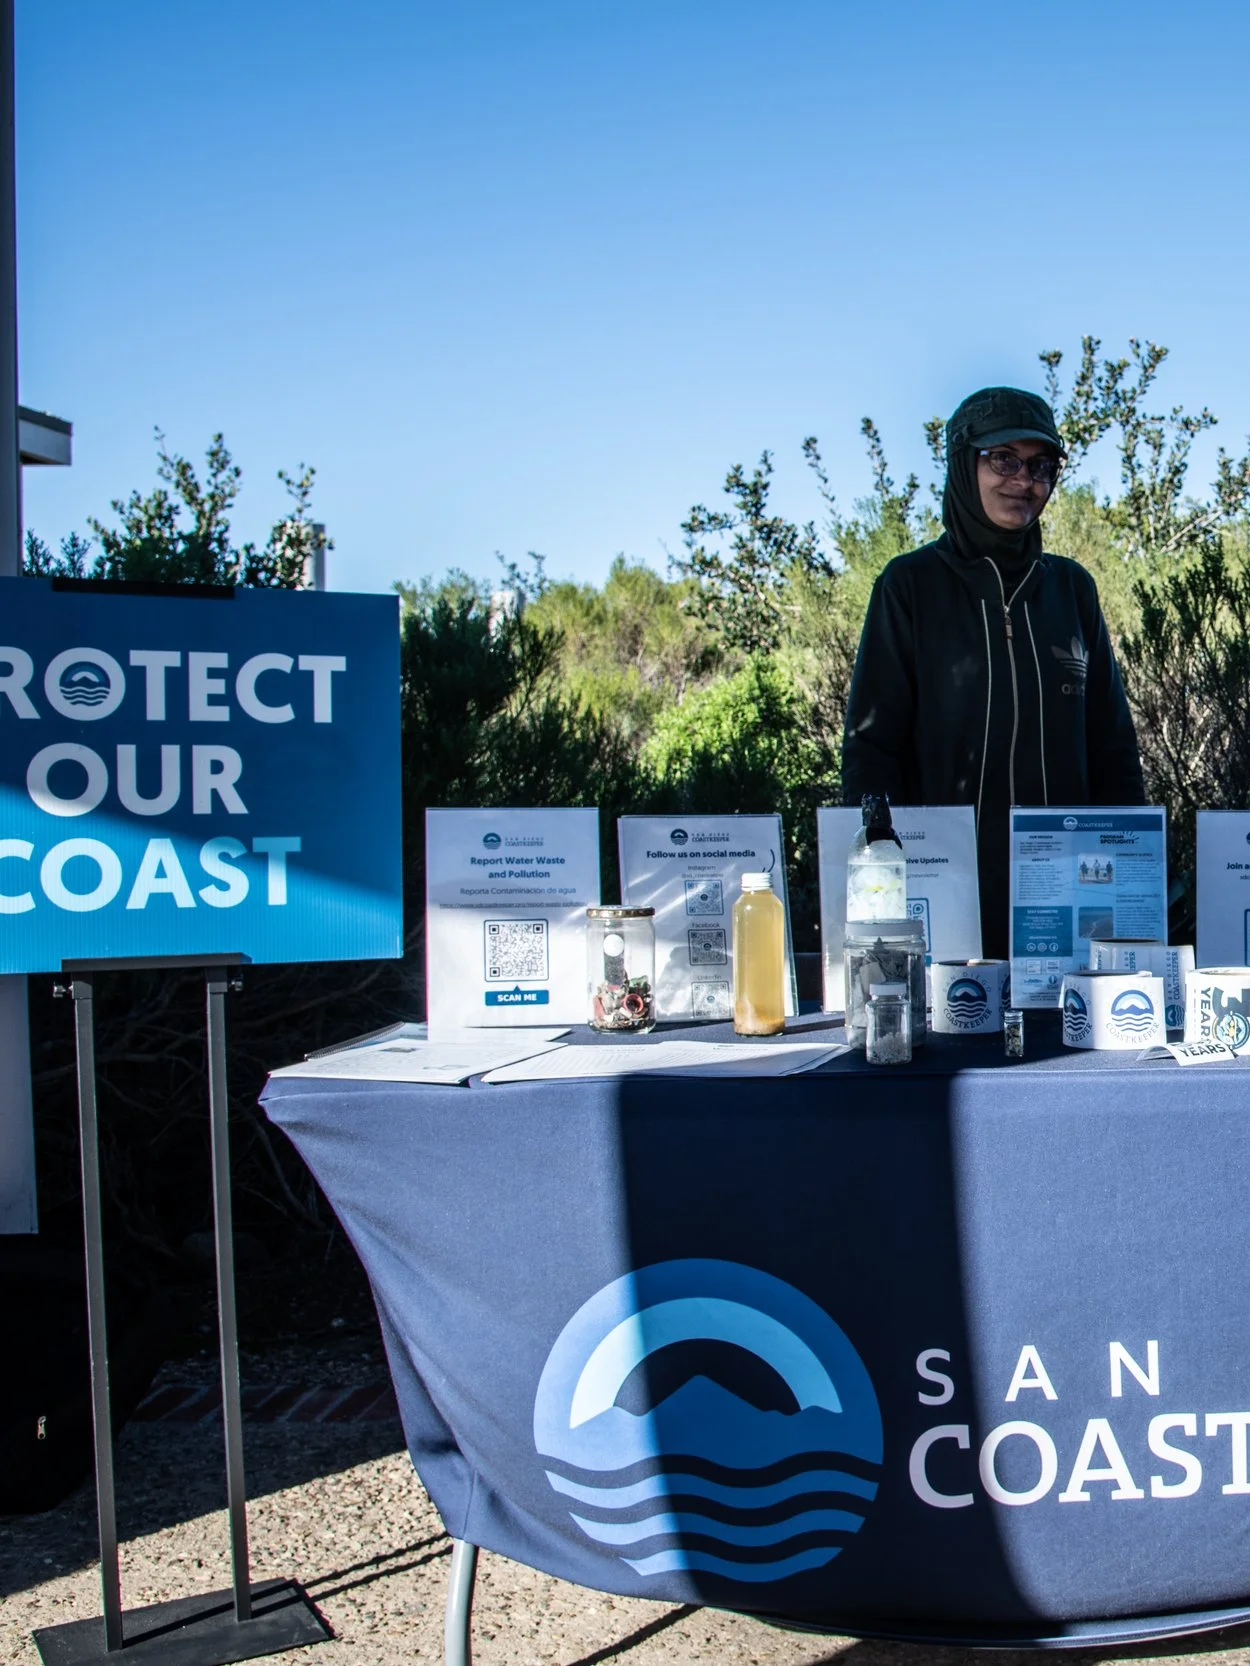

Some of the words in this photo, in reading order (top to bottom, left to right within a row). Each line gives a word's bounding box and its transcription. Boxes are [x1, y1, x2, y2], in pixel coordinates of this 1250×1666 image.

[0, 646, 347, 724] ROTECT
[26, 742, 249, 817] OUR
[470, 857, 503, 867] Report
[505, 857, 533, 865] Water
[536, 856, 566, 865] Waste
[646, 850, 675, 858] Follow
[703, 850, 727, 858] social
[729, 850, 756, 858] media
[488, 870, 506, 878] and
[509, 870, 550, 878] Pollution
[1226, 862, 1243, 870] Join
[0, 836, 301, 915] COAST
[460, 887, 489, 896] Reporta
[1172, 951, 1180, 1000] COASTKEEPER
[497, 993, 521, 1002] SCAN
[523, 993, 537, 1001] ME
[943, 1008, 992, 1029] COASTKEEPER
[1106, 1022, 1160, 1044] COASTKEEPER
[1180, 1043, 1227, 1057] YEARS
[915, 1340, 1160, 1405] SAN
